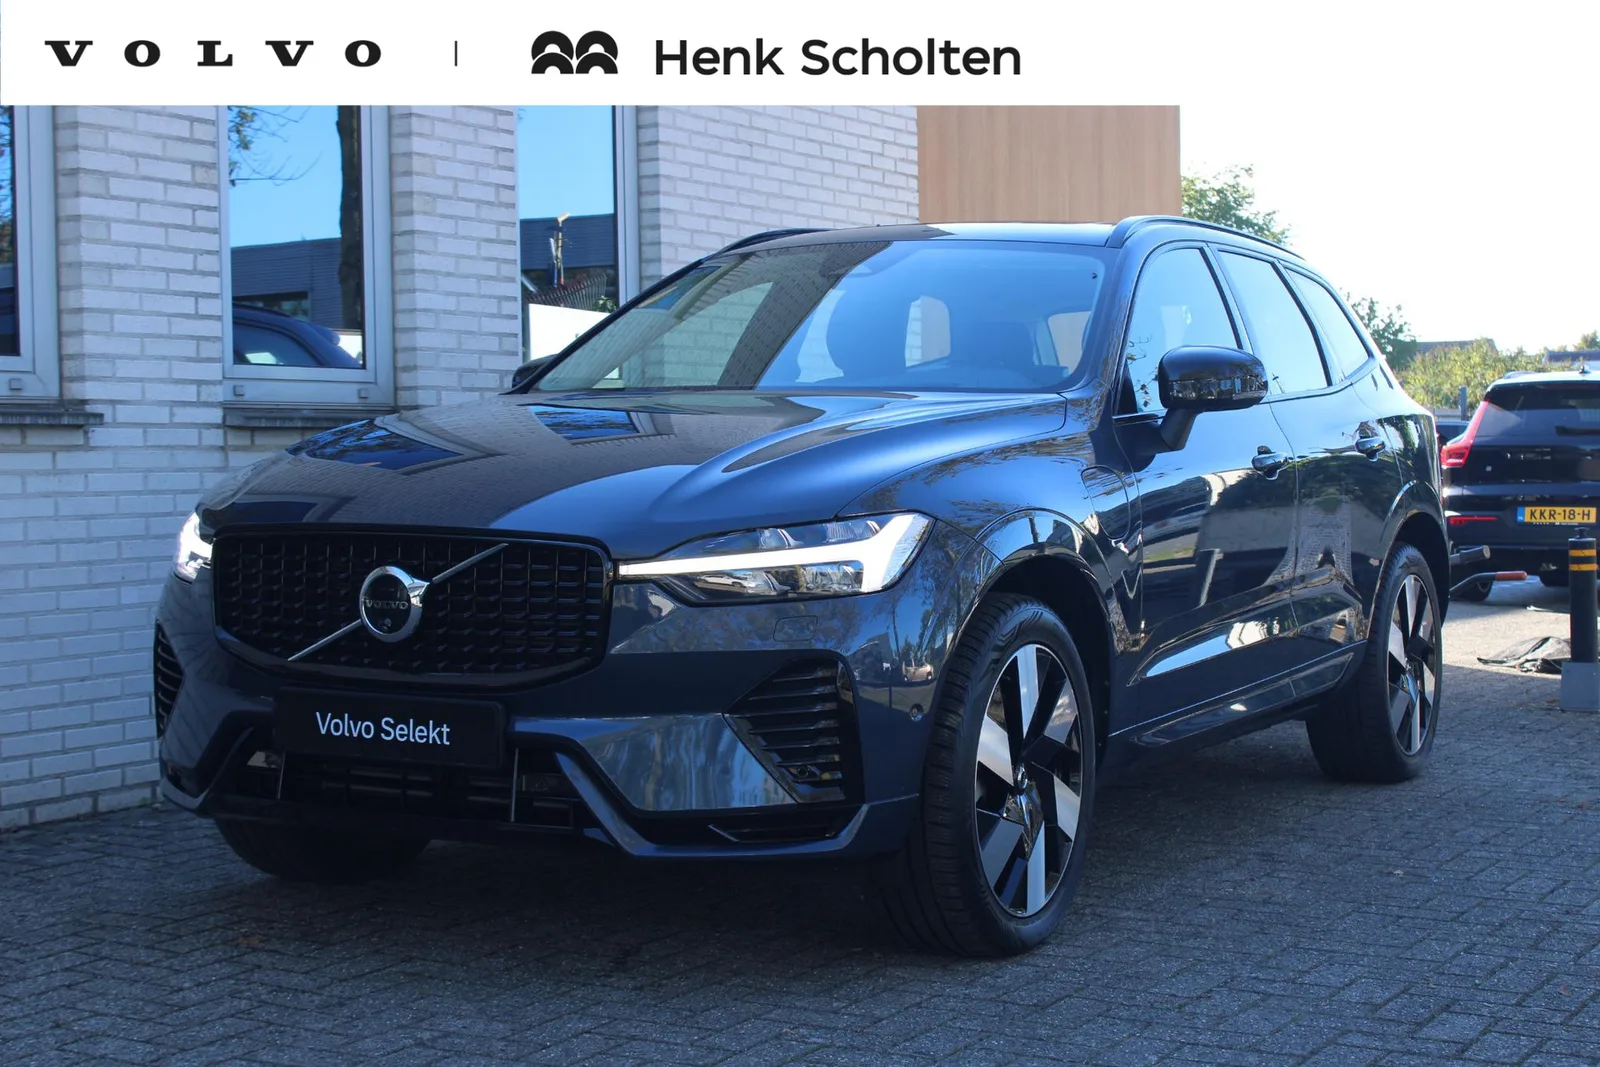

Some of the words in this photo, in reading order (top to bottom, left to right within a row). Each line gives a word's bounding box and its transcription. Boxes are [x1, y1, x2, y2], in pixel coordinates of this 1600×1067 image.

[1529, 508, 1591, 521] KKR-18-H
[364, 599, 409, 610] VOLVO
[315, 711, 375, 739] Volvo
[380, 716, 451, 745] Selekt
